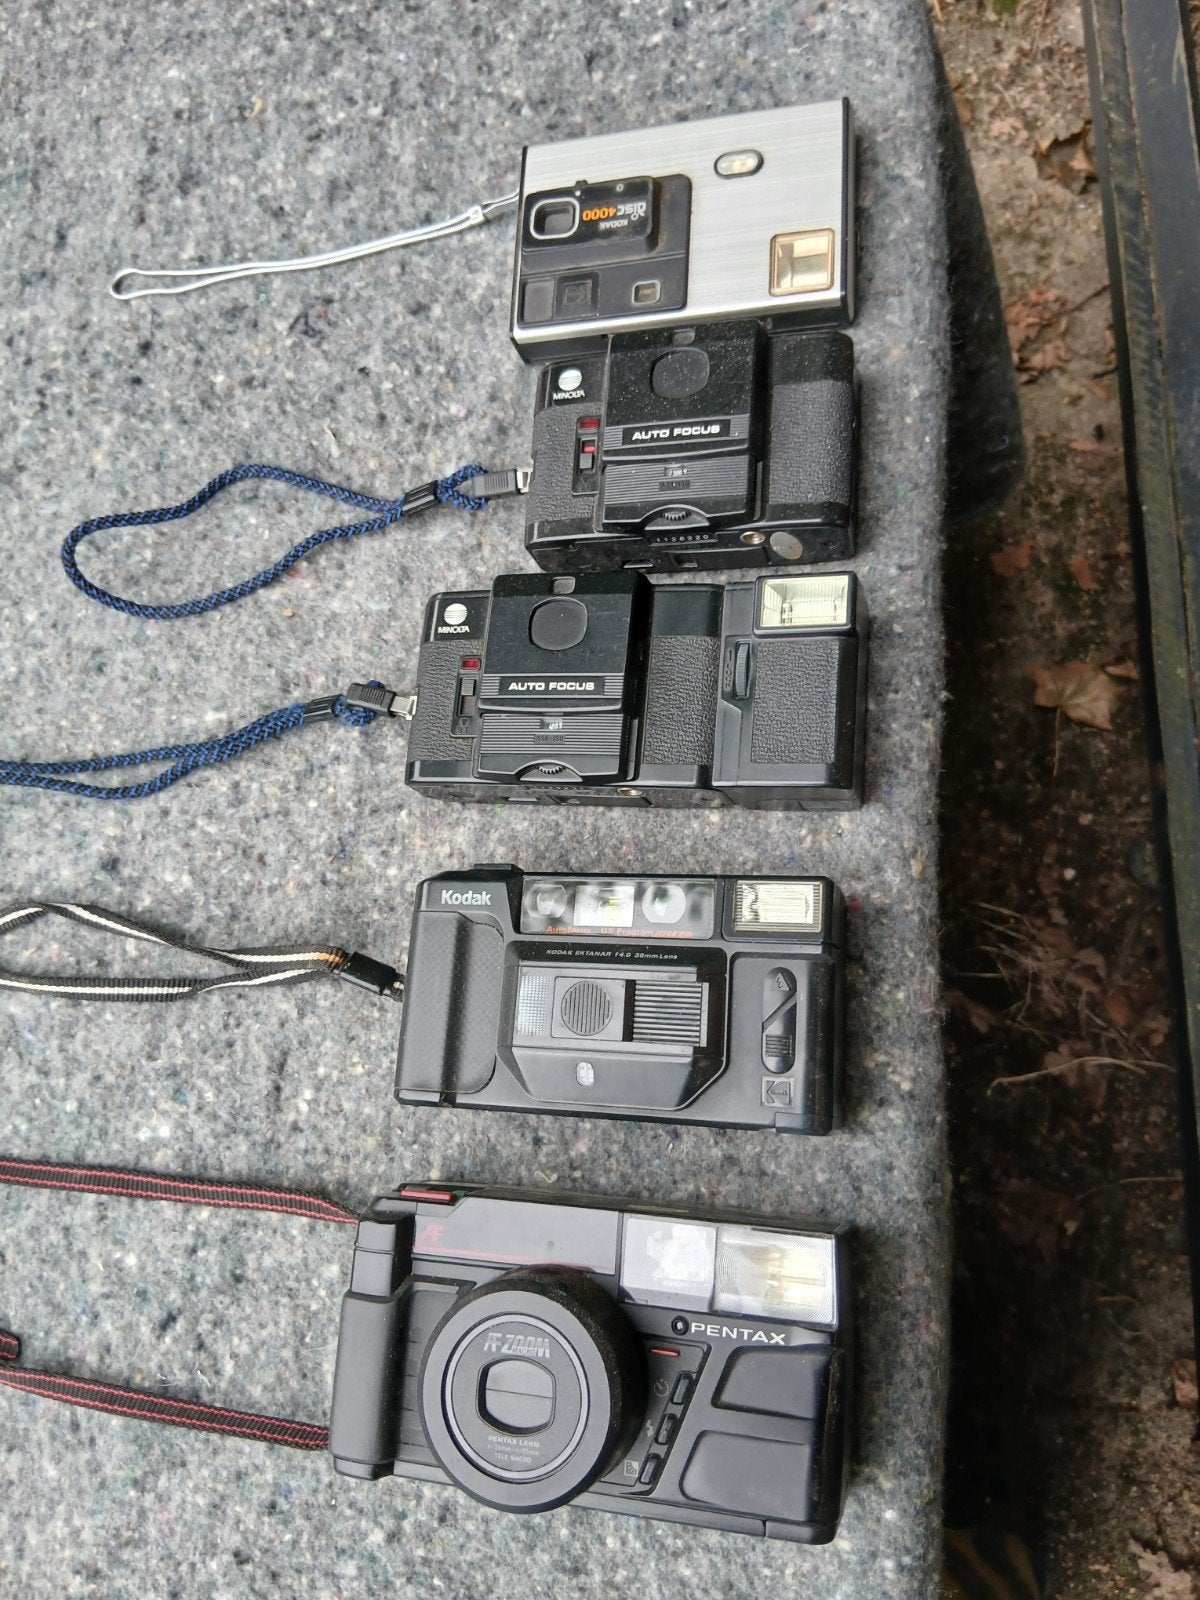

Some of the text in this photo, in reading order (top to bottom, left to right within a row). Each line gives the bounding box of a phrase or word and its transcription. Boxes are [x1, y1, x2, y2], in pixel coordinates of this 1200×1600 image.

[582, 206, 617, 222] 4000
[599, 219, 629, 230] KODAK
[552, 389, 586, 400] MINOLTA
[632, 424, 720, 441] AUTO FOCUS
[437, 625, 470, 634] MINOLTA
[508, 681, 595, 691] AUTO FOCUS
[441, 889, 492, 906] Kodak
[616, 927, 654, 938] Program
[690, 1322, 786, 1345] PENTAX
[488, 1435, 540, 1448] PENTAX LENS
